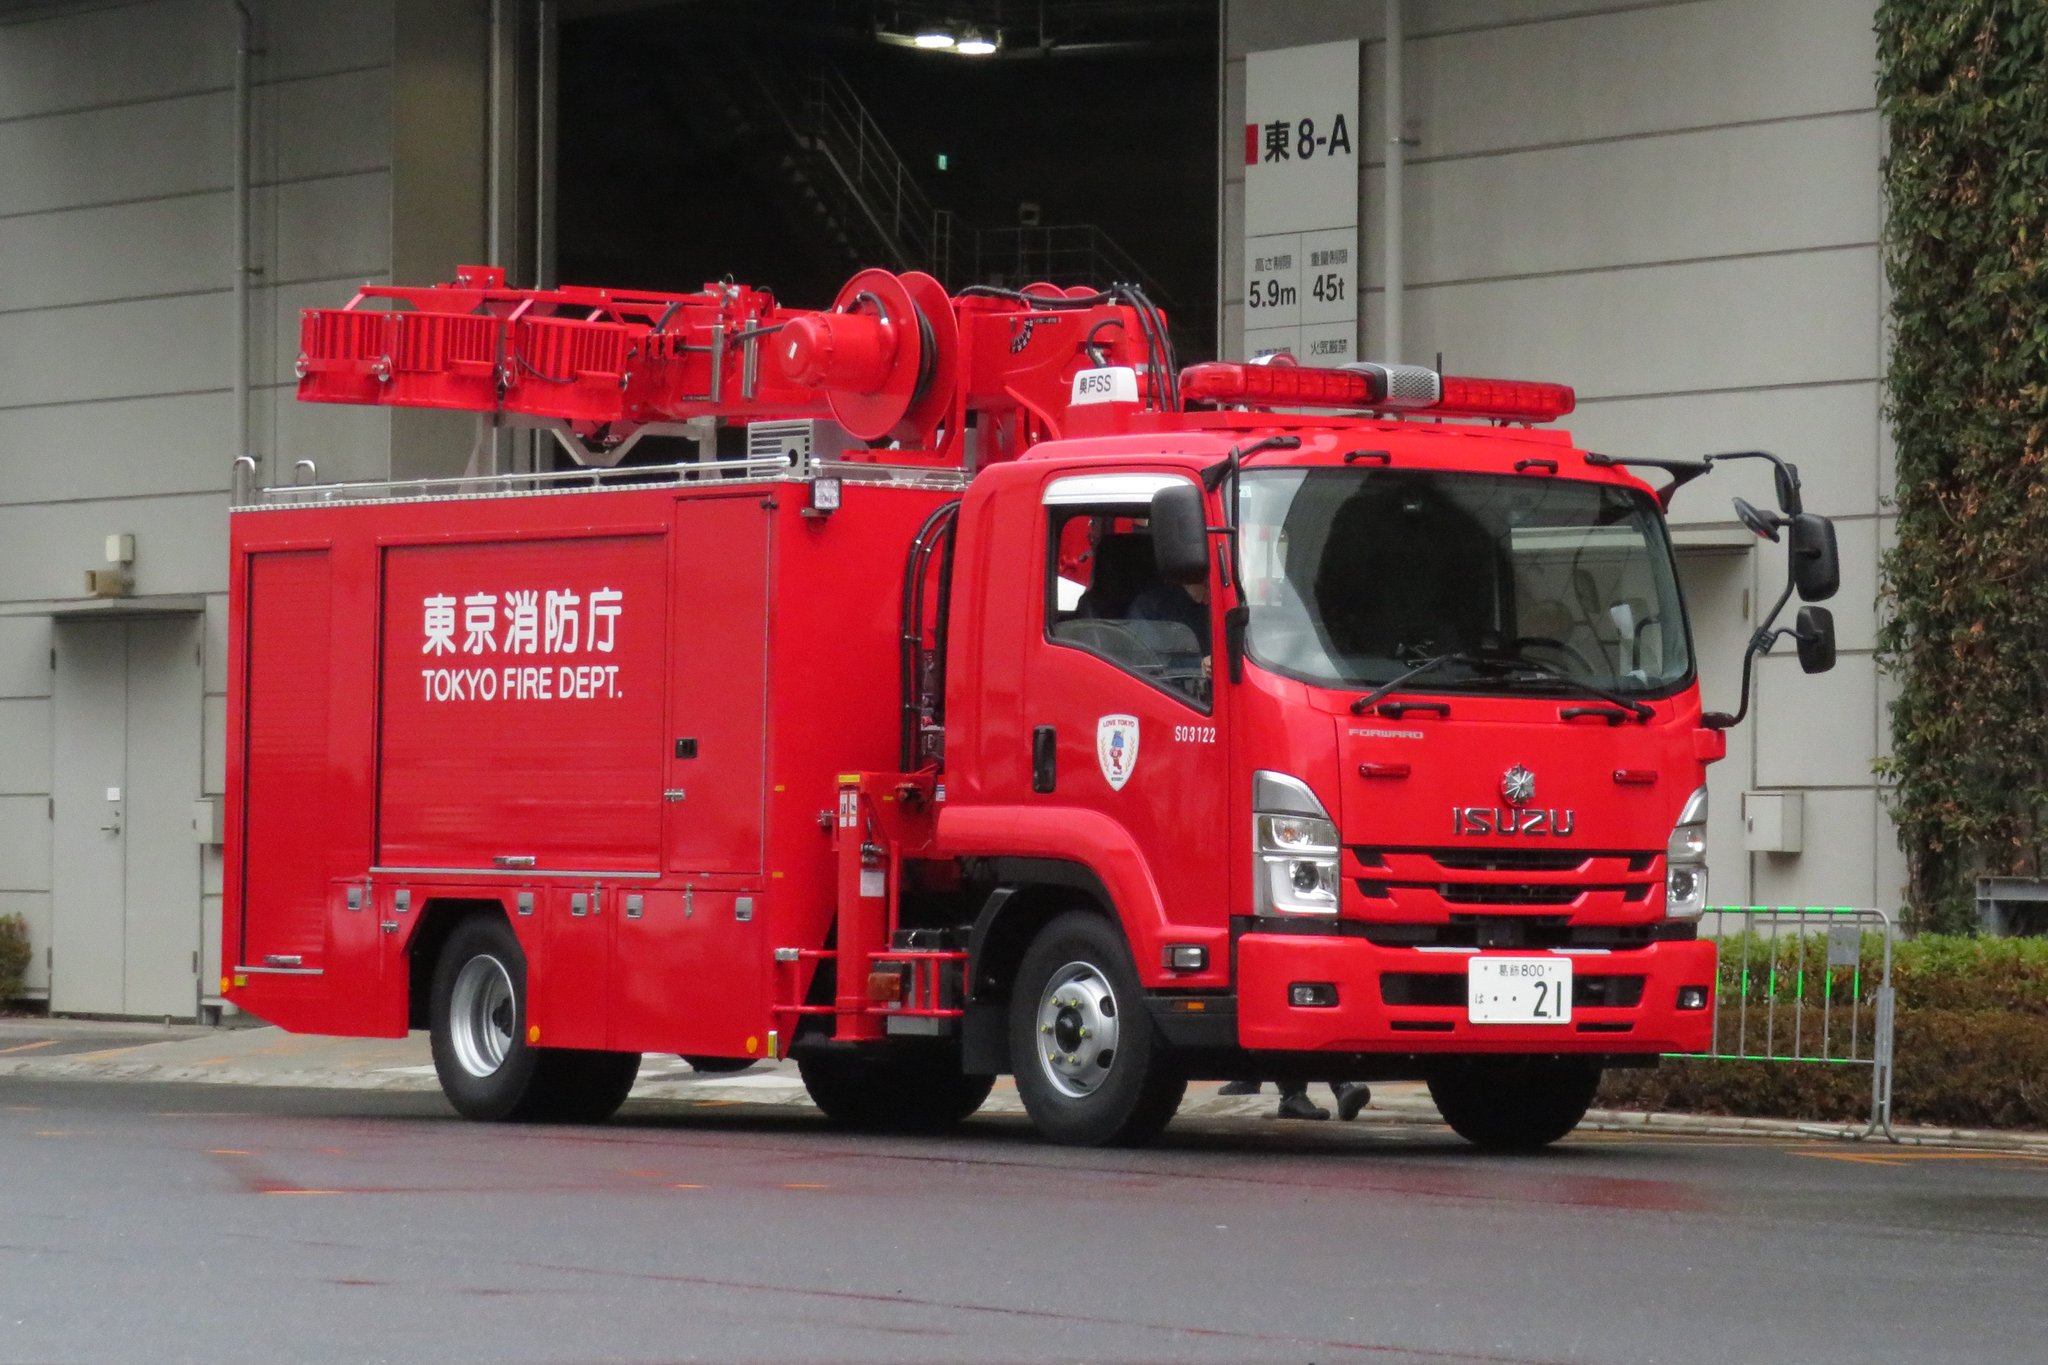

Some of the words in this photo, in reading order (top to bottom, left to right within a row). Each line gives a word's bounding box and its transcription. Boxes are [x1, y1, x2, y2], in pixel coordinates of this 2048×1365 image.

[1255, 255, 1291, 272] 高さ制限
[1310, 249, 1347, 267] 重量制限
[1249, 279, 1296, 308] 5.9m
[1313, 273, 1344, 302] 45t
[422, 586, 623, 656] 東京消防庁
[422, 668, 497, 701] TOKYO
[503, 667, 553, 700] FIRE
[559, 666, 623, 699] DEPT.
[1175, 725, 1216, 743] S03122
[1348, 728, 1424, 739] FORWARD
[1453, 806, 1574, 837] ISUZU
